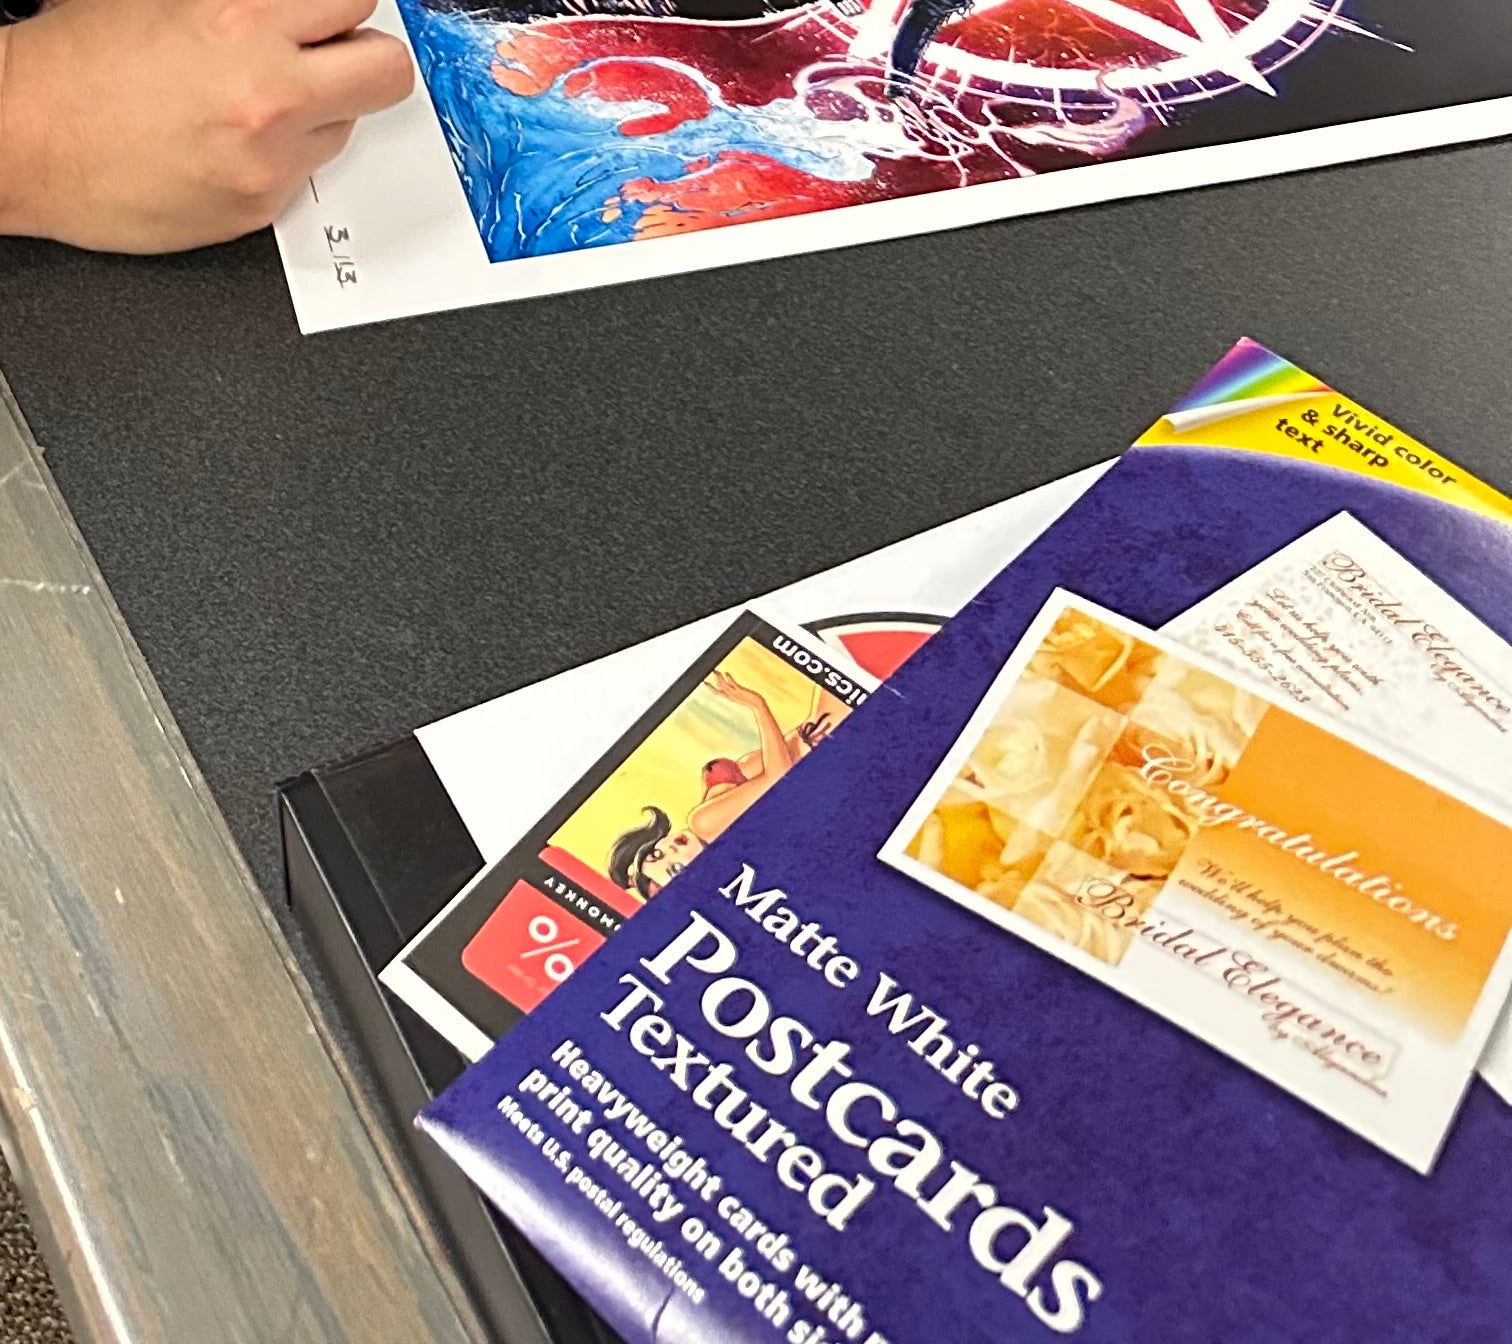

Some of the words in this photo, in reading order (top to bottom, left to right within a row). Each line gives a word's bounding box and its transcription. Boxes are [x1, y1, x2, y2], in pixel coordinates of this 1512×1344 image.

[1275, 417, 1324, 454] text
[1300, 408, 1320, 426] &
[1322, 423, 1390, 468] sharp
[1332, 403, 1394, 446] Vivid
[1394, 446, 1457, 485] color
[1321, 550, 1425, 626] Bridal
[1411, 623, 1511, 713] Elegance
[543, 876, 622, 931] MONKEY
[1140, 742, 1459, 941] Congratulations
[717, 863, 859, 989] Matte
[866, 971, 1022, 1120] White
[1077, 877, 1227, 964] Bridal
[1223, 950, 1381, 1064] Elegance
[497, 1095, 546, 1146] Meets
[564, 1166, 624, 1220] postal
[614, 1212, 707, 1306] regulations
[518, 1066, 593, 1135] print
[587, 1127, 685, 1223] quality
[680, 1216, 723, 1261] on
[718, 1246, 792, 1328] both
[550, 1038, 722, 1202] Heavyweight
[717, 1195, 796, 1272] cards
[794, 1264, 866, 1340] with
[600, 972, 876, 1231] Textured
[639, 909, 1103, 1334] Postcards
